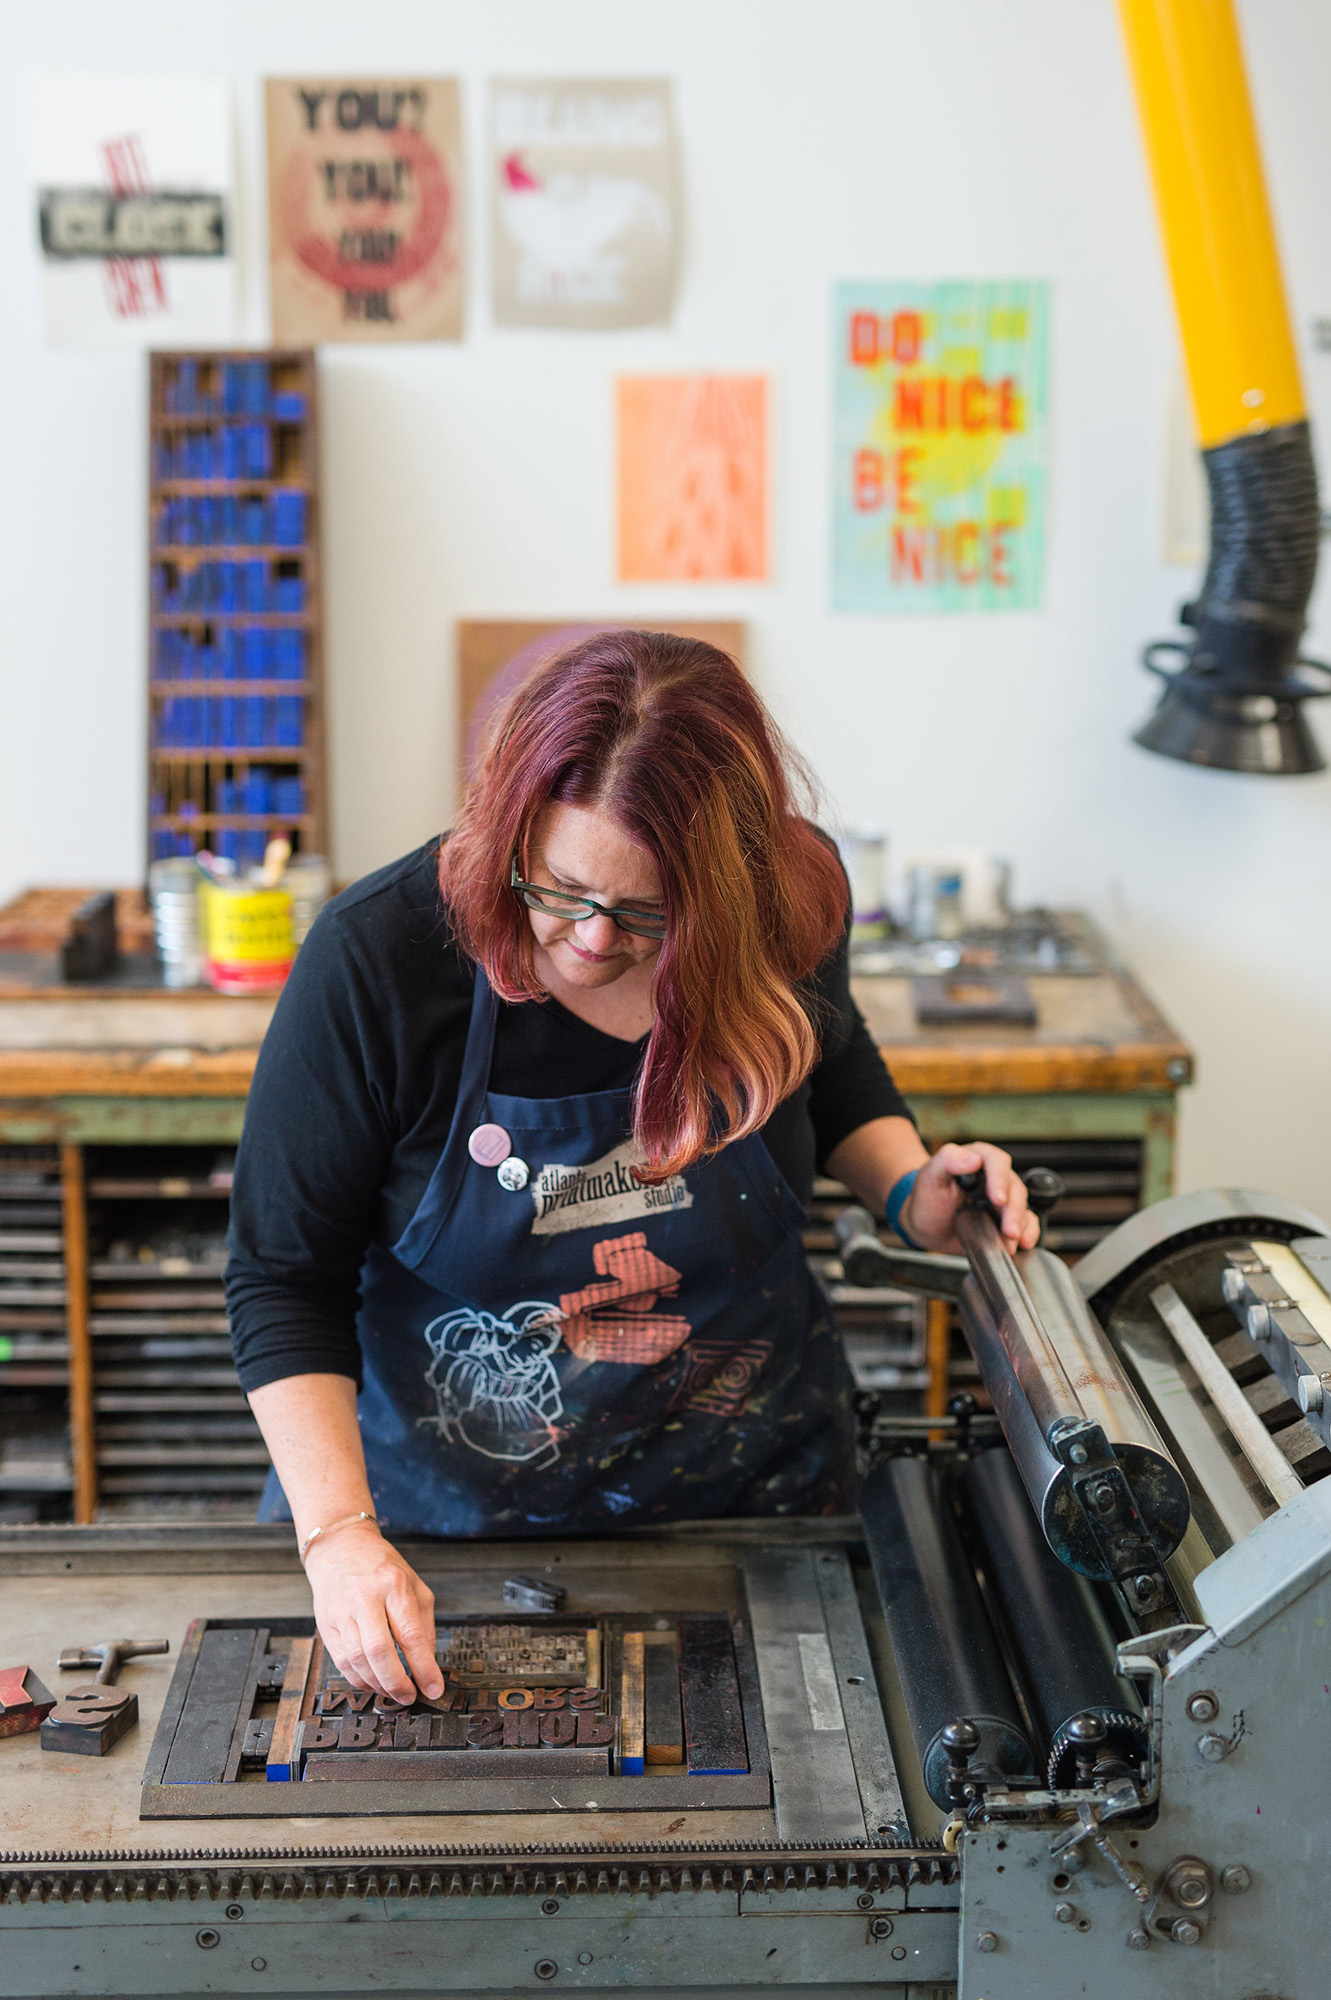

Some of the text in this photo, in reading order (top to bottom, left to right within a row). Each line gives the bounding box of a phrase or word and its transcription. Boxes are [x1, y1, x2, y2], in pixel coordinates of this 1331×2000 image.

[850, 311, 922, 367] DO
[894, 375, 1023, 434] NICE
[855, 447, 927, 514] BE
[891, 521, 1015, 589] NICE
[644, 1181, 686, 1209] studio
